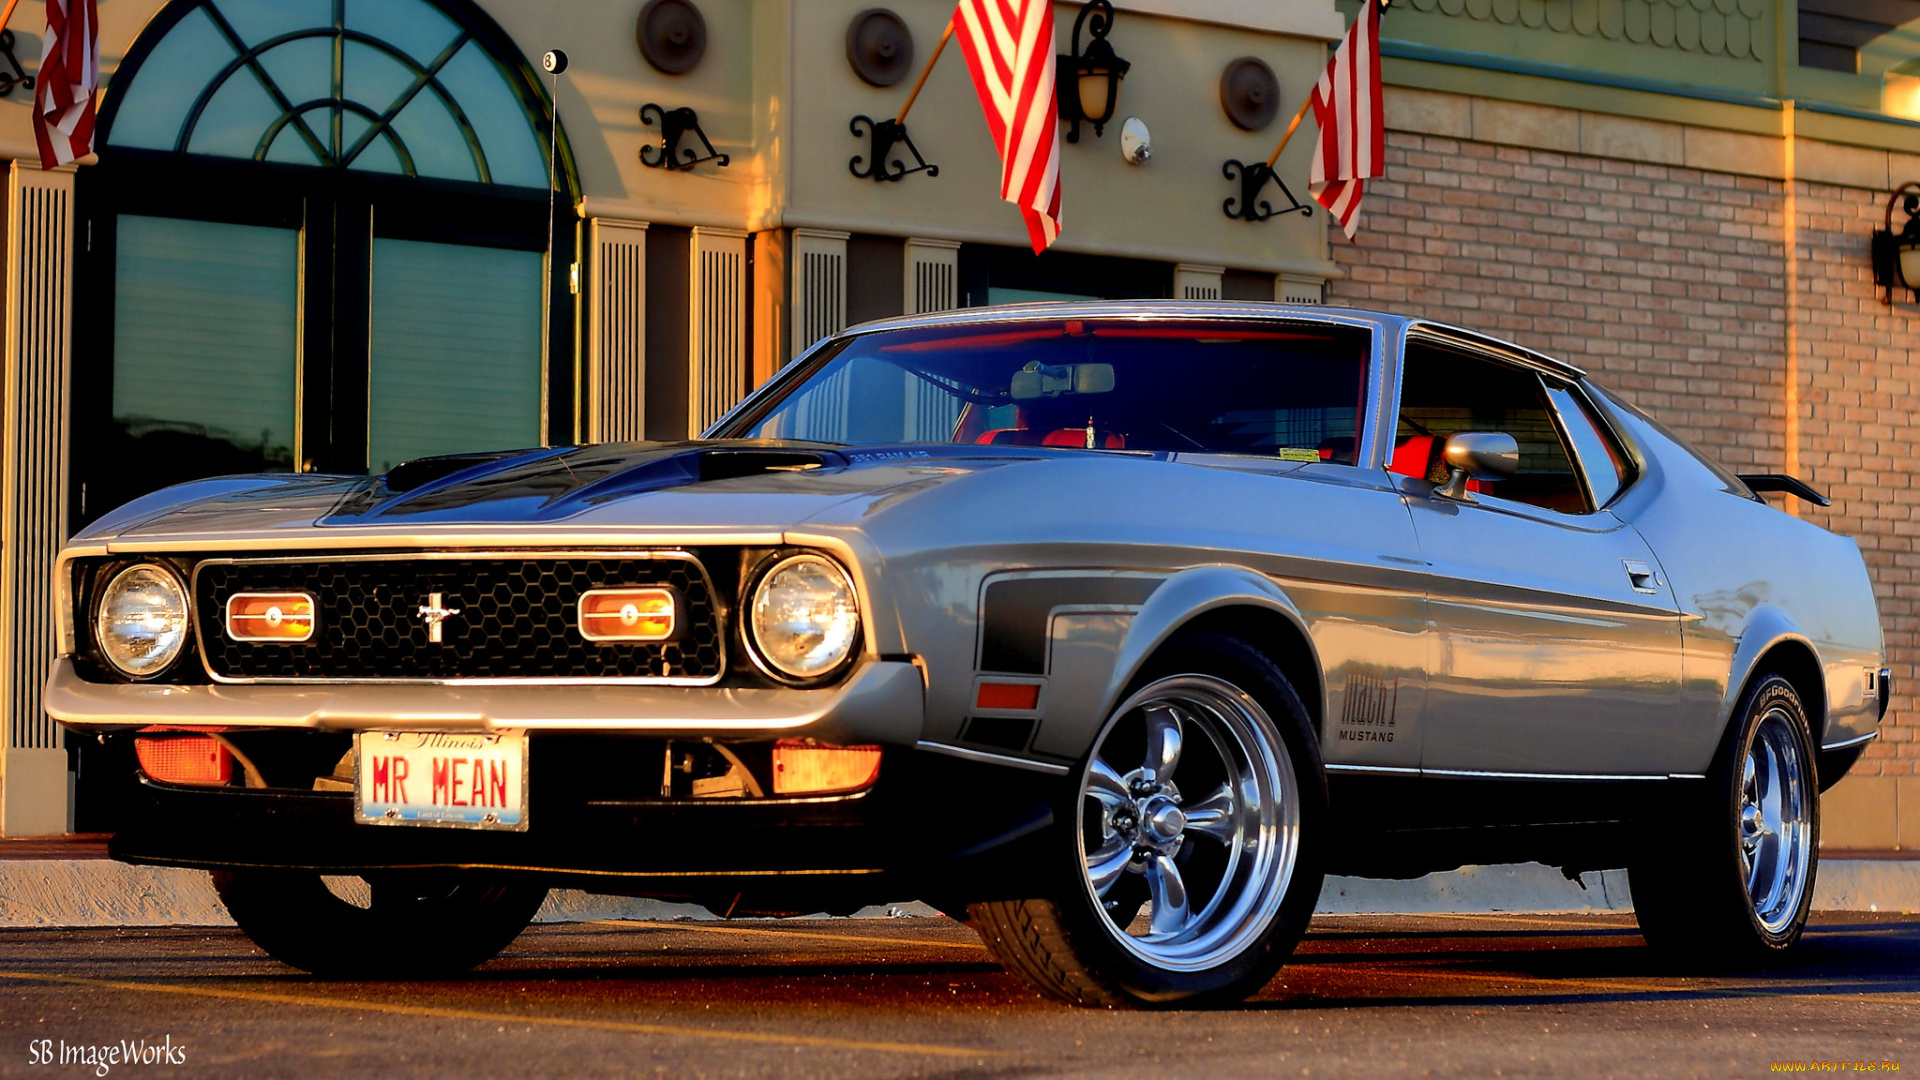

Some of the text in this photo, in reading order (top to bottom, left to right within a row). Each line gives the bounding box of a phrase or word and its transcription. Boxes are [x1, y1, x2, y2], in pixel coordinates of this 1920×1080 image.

[544, 54, 551, 68] 8
[850, 450, 932, 462] 351 RAM AIR
[412, 733, 484, 750] Illinois
[1339, 730, 1394, 742] MUSTANG
[373, 756, 506, 808] MR MEAN
